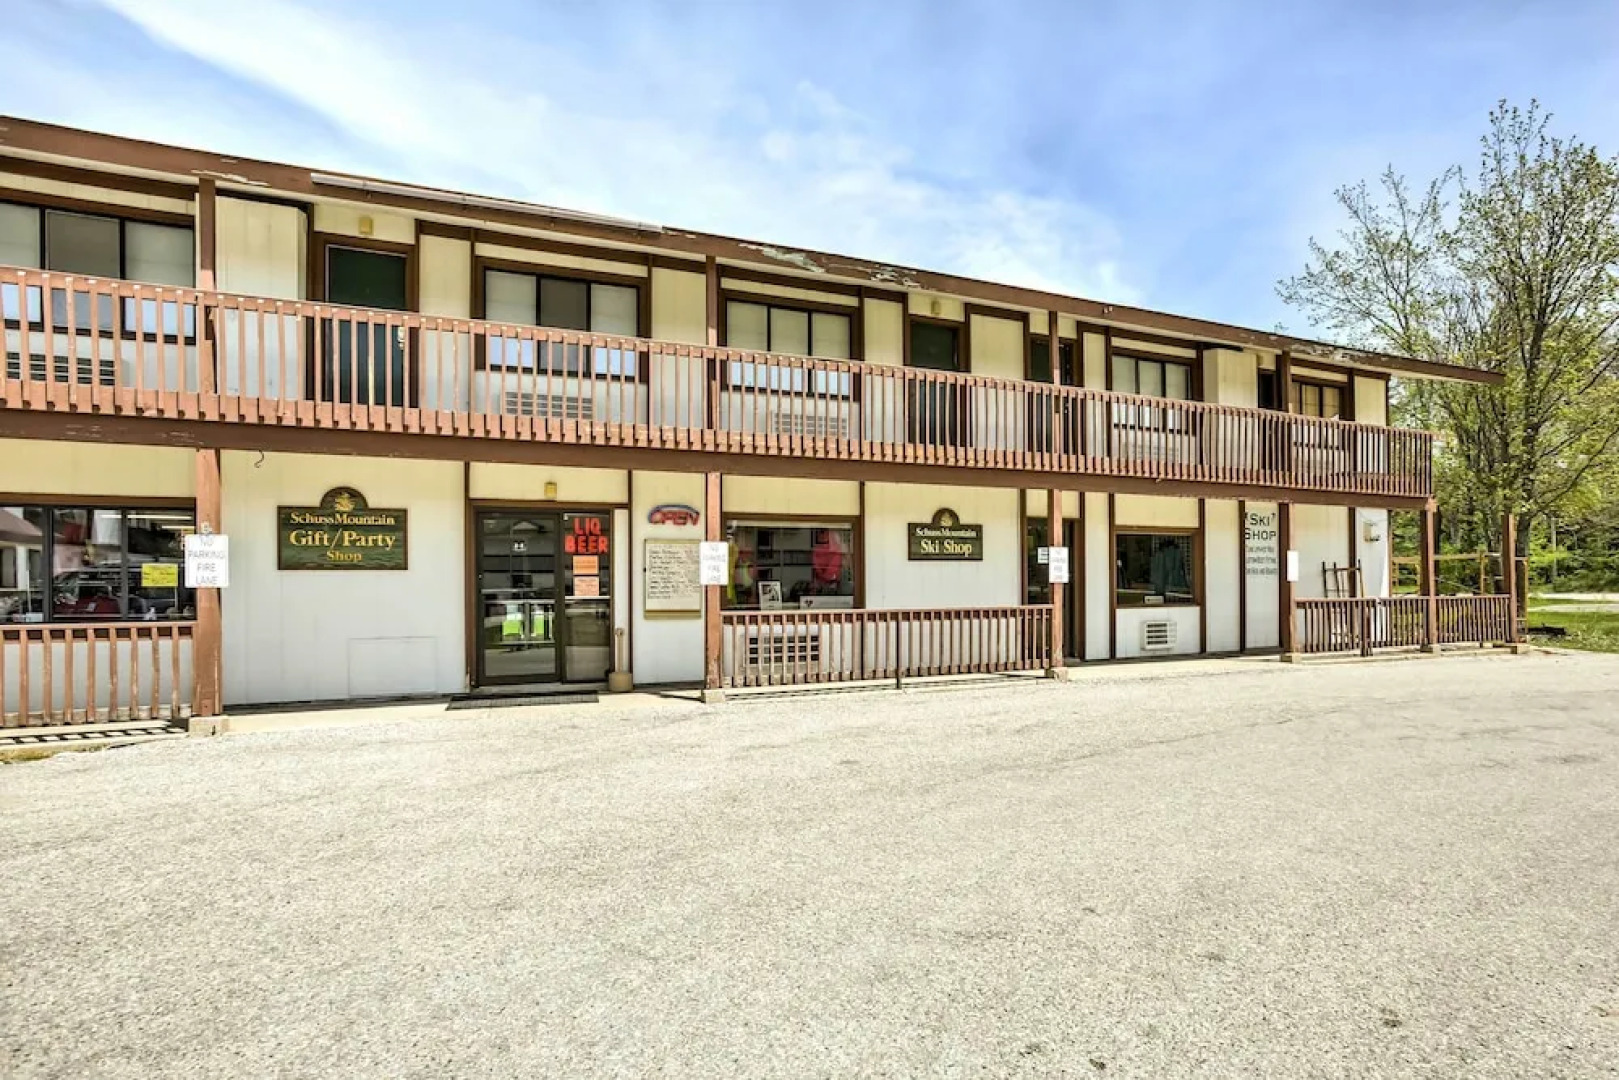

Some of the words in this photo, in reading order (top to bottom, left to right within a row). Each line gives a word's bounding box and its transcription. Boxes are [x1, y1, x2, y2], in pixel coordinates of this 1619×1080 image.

[288, 528, 396, 551] Gift/Party
[564, 535, 608, 553] BEER
[187, 550, 225, 560] PARKING
[920, 539, 940, 553] Ski
[943, 539, 972, 558] Shop
[326, 550, 363, 563] Shop
[197, 562, 216, 573] FIRE
[195, 575, 218, 586] LANE
